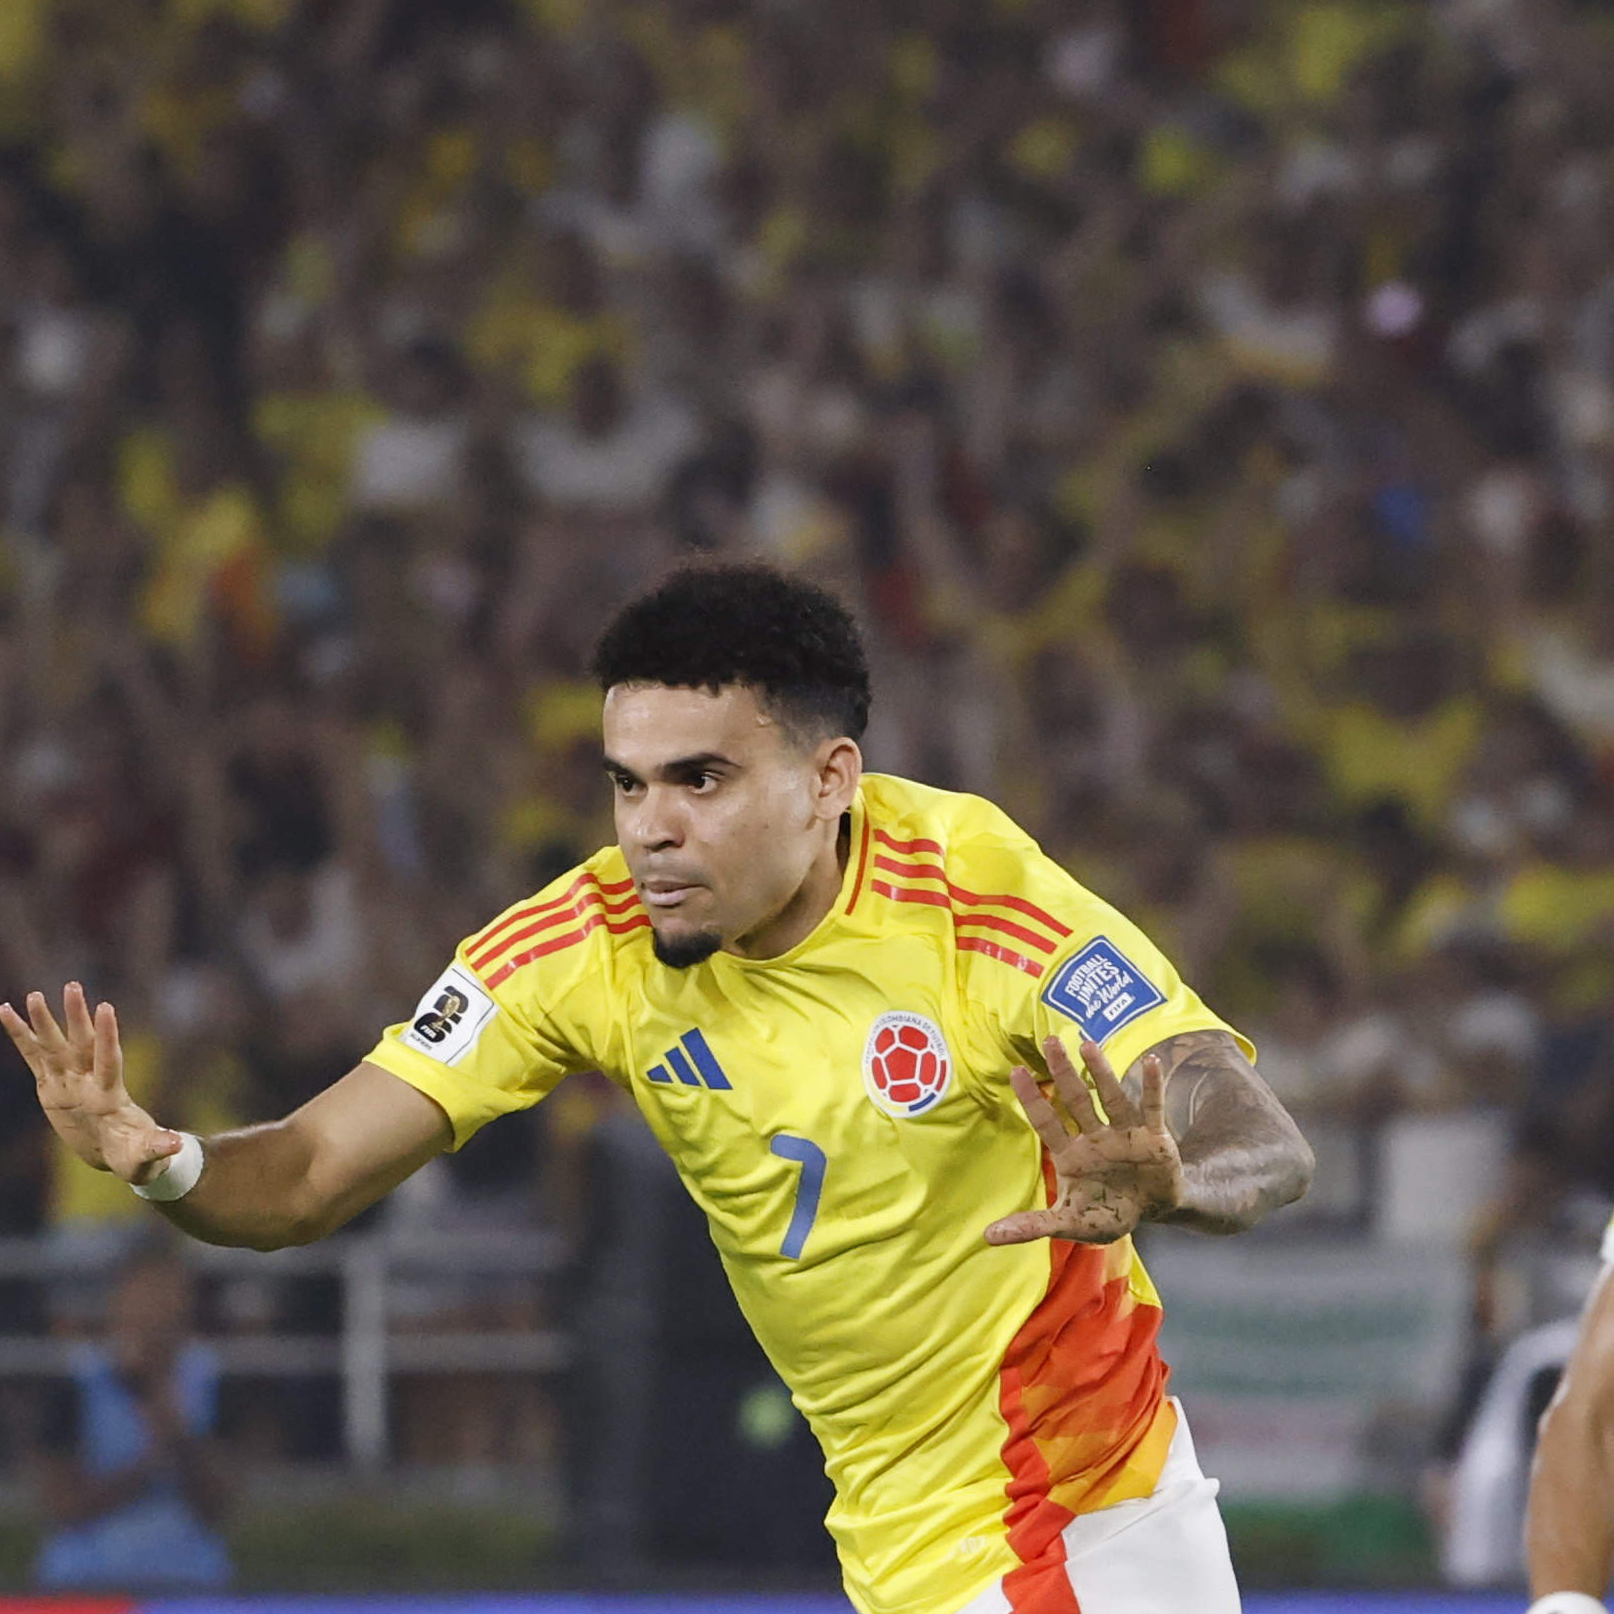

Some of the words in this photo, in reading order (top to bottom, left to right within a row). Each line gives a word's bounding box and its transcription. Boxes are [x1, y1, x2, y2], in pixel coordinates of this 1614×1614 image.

[1064, 953, 1107, 997] FOOTBALL
[1109, 998, 1128, 1016] FIFA
[770, 1134, 827, 1259] 7
